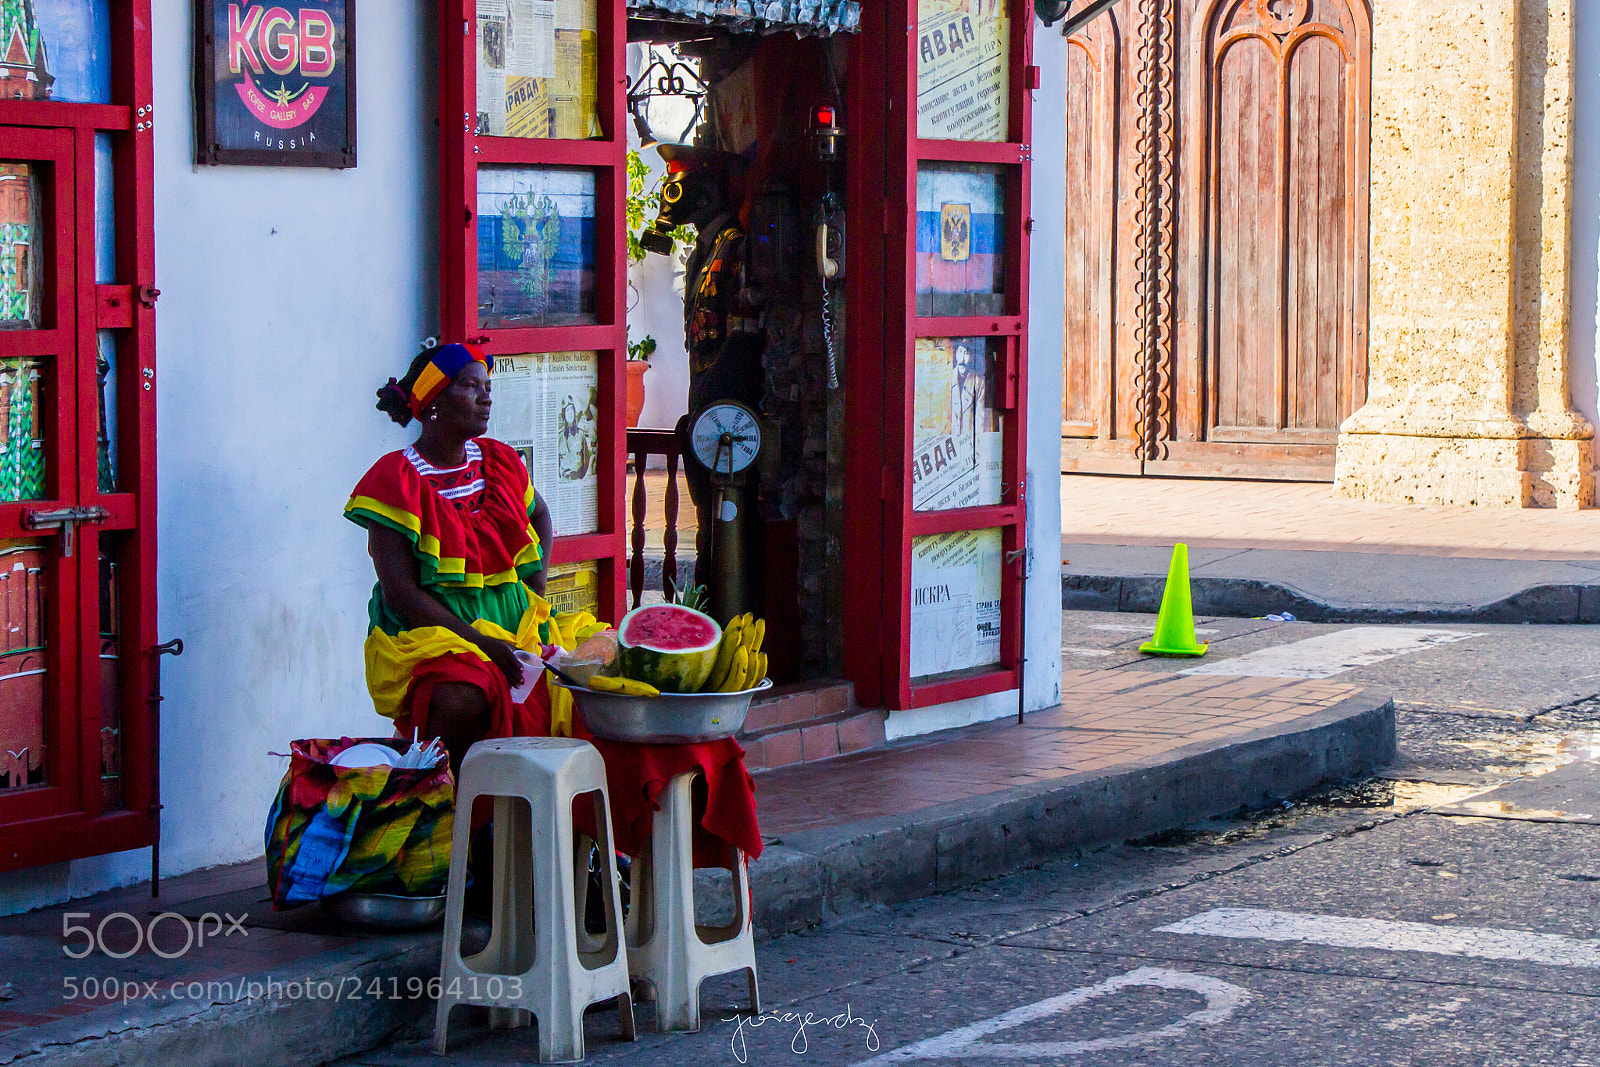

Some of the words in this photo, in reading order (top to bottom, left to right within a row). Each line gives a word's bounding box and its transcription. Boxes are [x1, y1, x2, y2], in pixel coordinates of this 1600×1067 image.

[228, 4, 335, 77] KGB
[270, 109, 297, 121] GALLERY
[254, 130, 316, 150] RUSSIA
[492, 358, 515, 374] СКРА
[914, 584, 951, 607] ИСКРА
